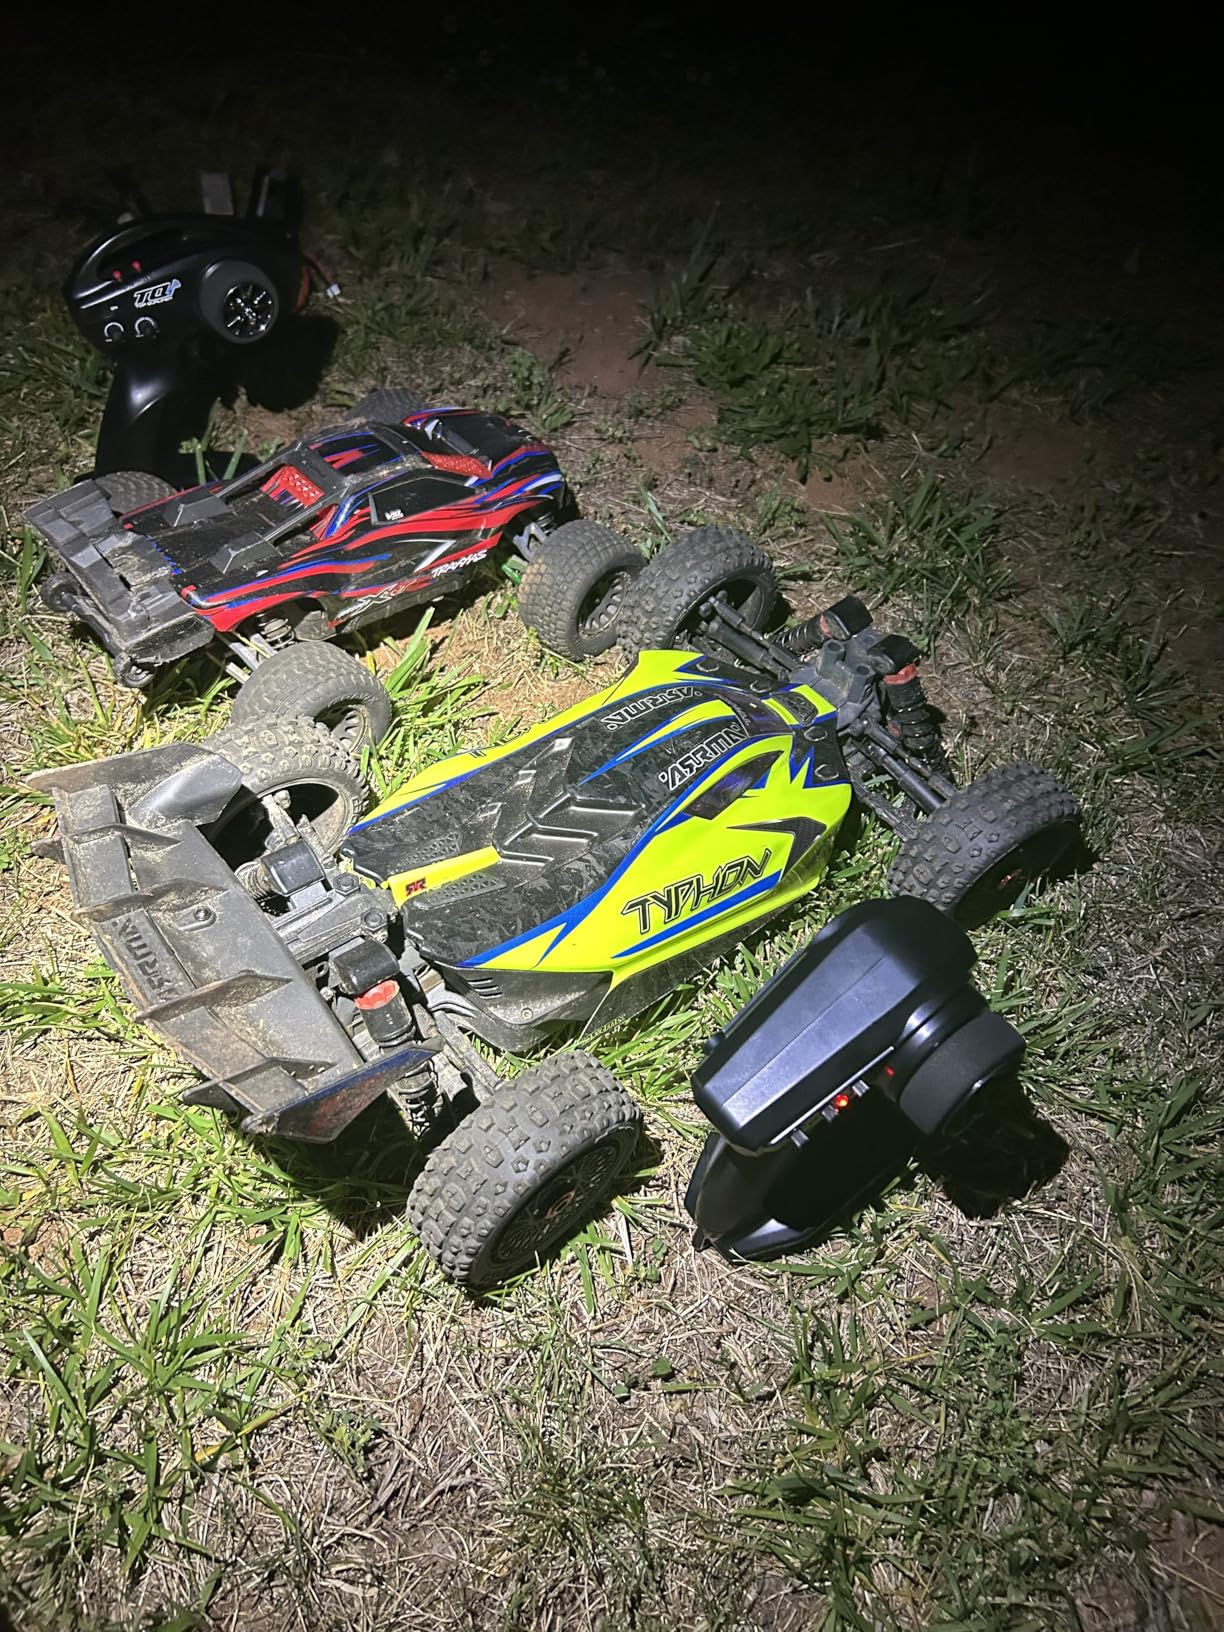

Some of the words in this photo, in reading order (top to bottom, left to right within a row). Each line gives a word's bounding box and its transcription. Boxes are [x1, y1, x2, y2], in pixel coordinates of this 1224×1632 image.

[432, 550, 487, 578] TRAXXAS
[658, 722, 748, 791] ARRMA
[621, 848, 772, 934] TYPHON
